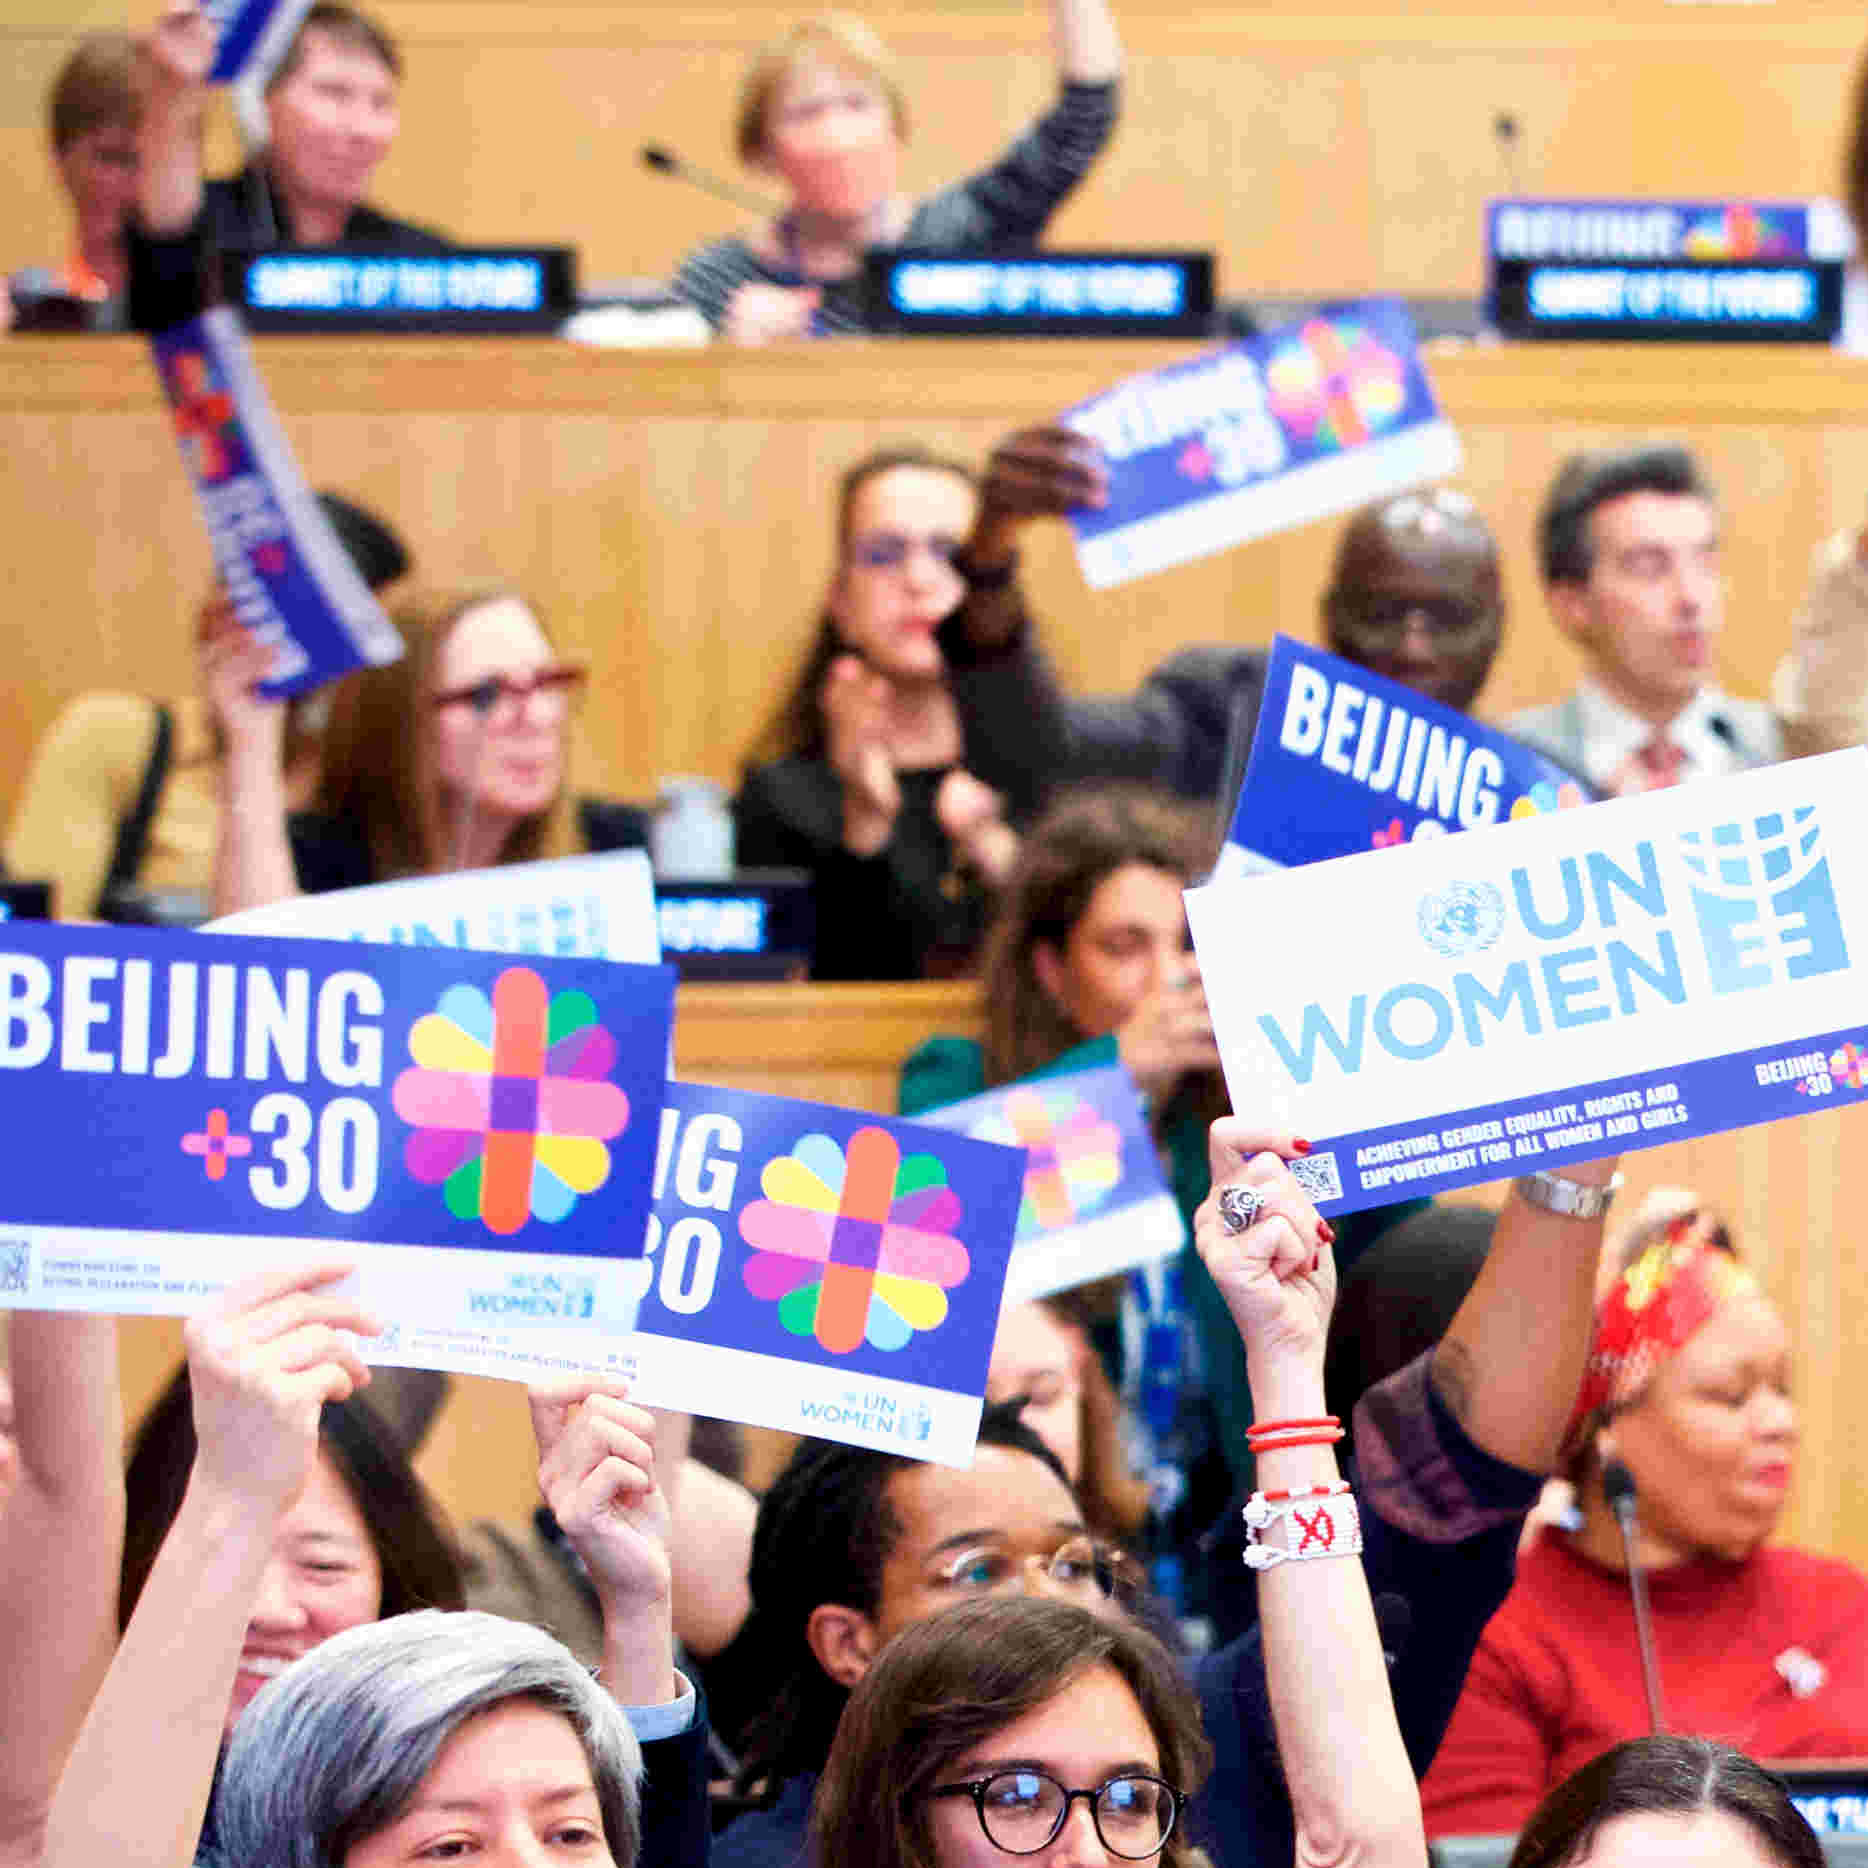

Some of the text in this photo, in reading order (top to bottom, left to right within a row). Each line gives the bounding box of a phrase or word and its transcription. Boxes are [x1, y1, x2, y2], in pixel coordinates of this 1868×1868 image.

[1280, 664, 1503, 824] BEIJING
[1512, 841, 1669, 940] UN
[0, 952, 385, 1088] BEIJING
[1257, 931, 1688, 1086] WOMEN
[1755, 1051, 1828, 1086] BEIJING
[1795, 1072, 1833, 1097] +30
[180, 1092, 380, 1213] +30
[1356, 1083, 1679, 1168] ACHIEVING GENDER EQUALITY, RIGHTS AND
[1360, 1104, 1689, 1190] EMPOWERMENT FOR ALL WOMEN AND GIRLS
[799, 1399, 896, 1434] WOMEN
